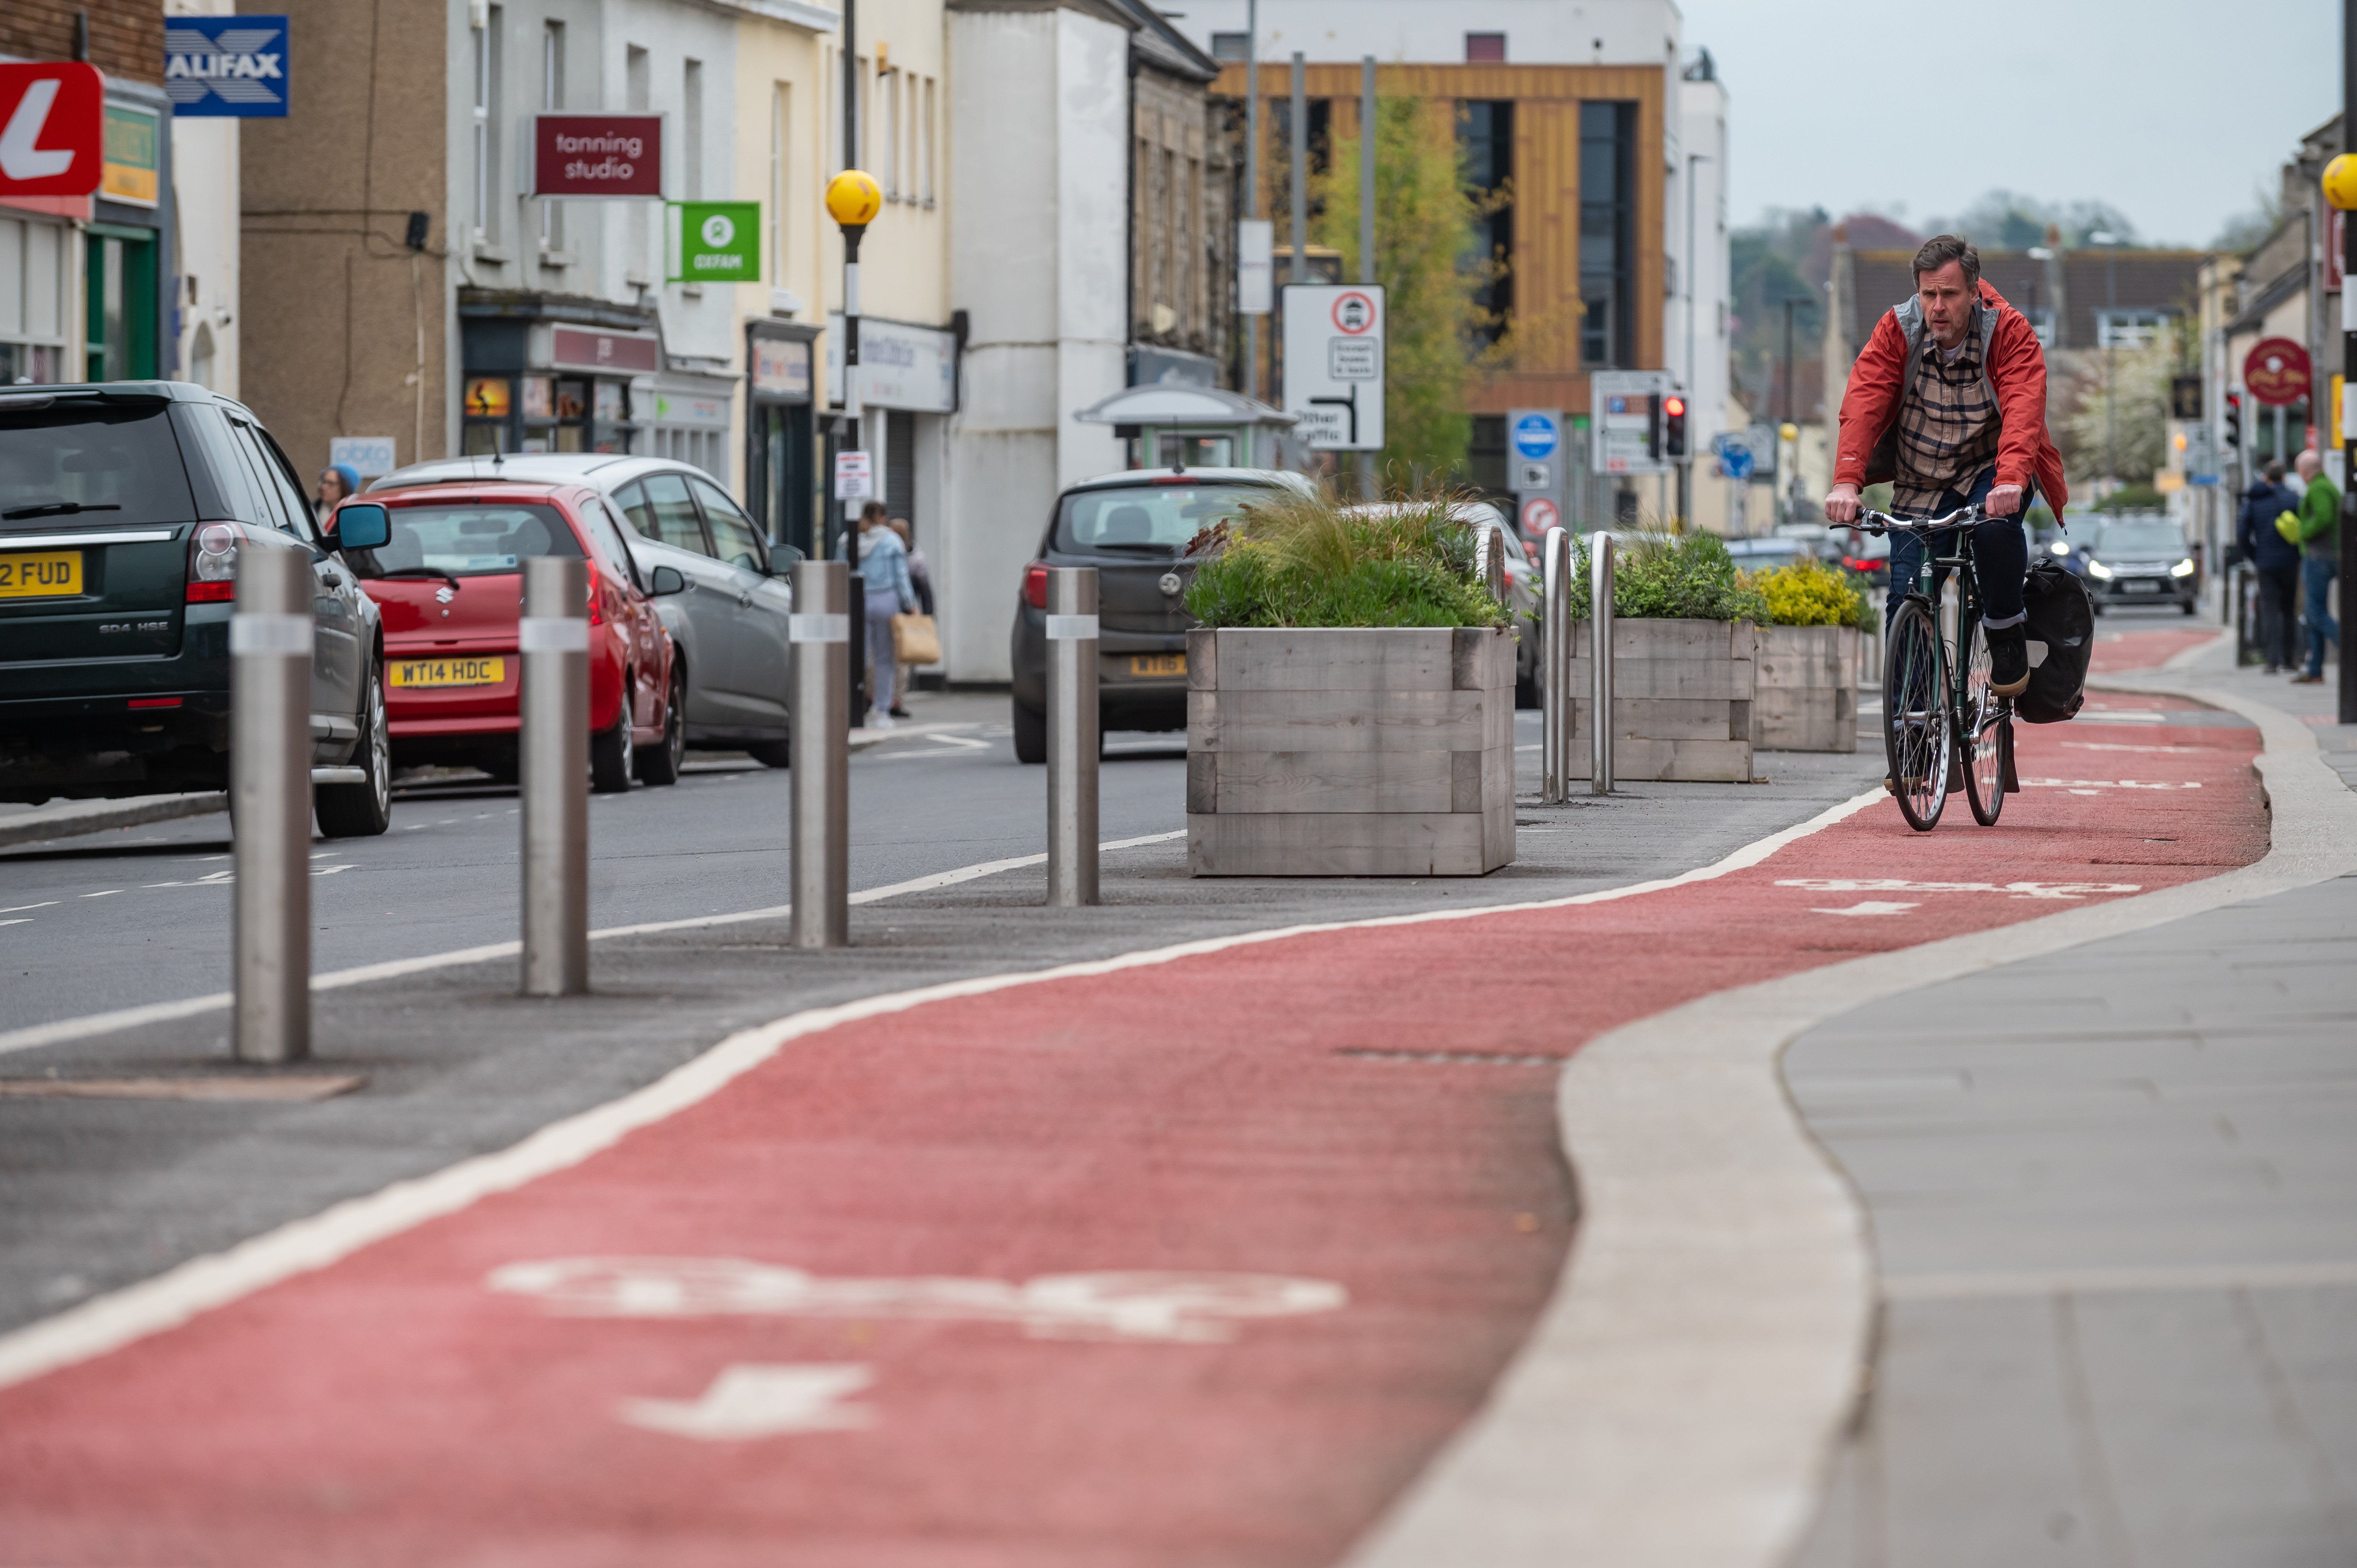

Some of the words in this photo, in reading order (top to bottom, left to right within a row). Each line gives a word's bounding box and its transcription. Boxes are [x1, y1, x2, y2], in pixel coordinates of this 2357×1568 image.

[166, 53, 283, 79] ALIFAX
[556, 131, 643, 159] tanning
[565, 156, 634, 180] studio
[693, 254, 743, 270] OXFAM
[0, 563, 12, 586] 2
[21, 562, 70, 585] FUD
[99, 623, 131, 633] SD4
[137, 622, 168, 631] HSE
[402, 662, 445, 682] WT14
[452, 660, 490, 680] HDC
